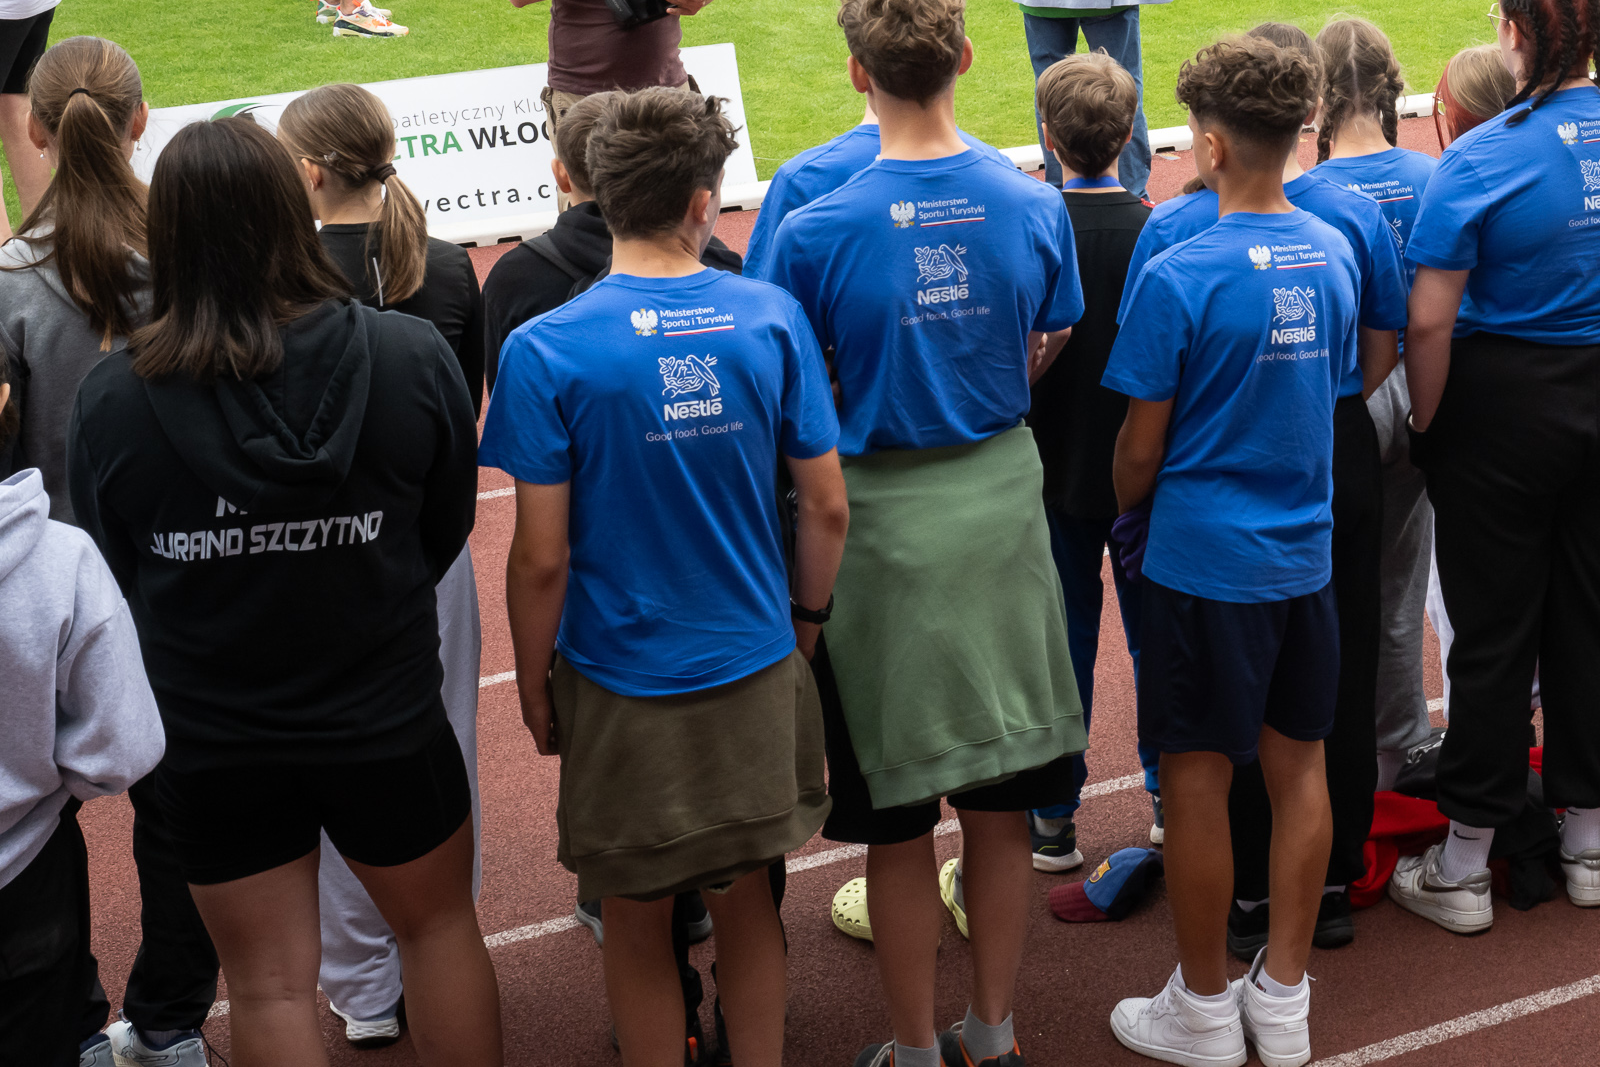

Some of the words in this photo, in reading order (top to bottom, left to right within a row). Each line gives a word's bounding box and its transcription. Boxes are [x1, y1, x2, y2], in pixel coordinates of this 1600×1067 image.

[514, 98, 544, 115] Klu
[1581, 129, 1600, 137] Sportu
[918, 198, 968, 209] Ministerstwo
[919, 210, 942, 220] Sportu
[950, 205, 985, 216] Turystyki
[1569, 215, 1588, 227] Good
[917, 284, 969, 305] Nestlé
[660, 306, 715, 318] Ministerstwo
[901, 313, 923, 325] Good
[926, 312, 948, 321] food,
[951, 308, 974, 318] Good
[977, 306, 990, 315] life
[662, 319, 689, 329] Sportu
[696, 314, 734, 324] Turystyki
[1271, 326, 1315, 344] Nestlé
[663, 397, 722, 421] Nestlé
[646, 427, 672, 441] Good
[675, 427, 698, 438] food,
[701, 424, 728, 435] Good
[730, 421, 743, 432] life
[249, 510, 384, 554] SZCZYTNO
